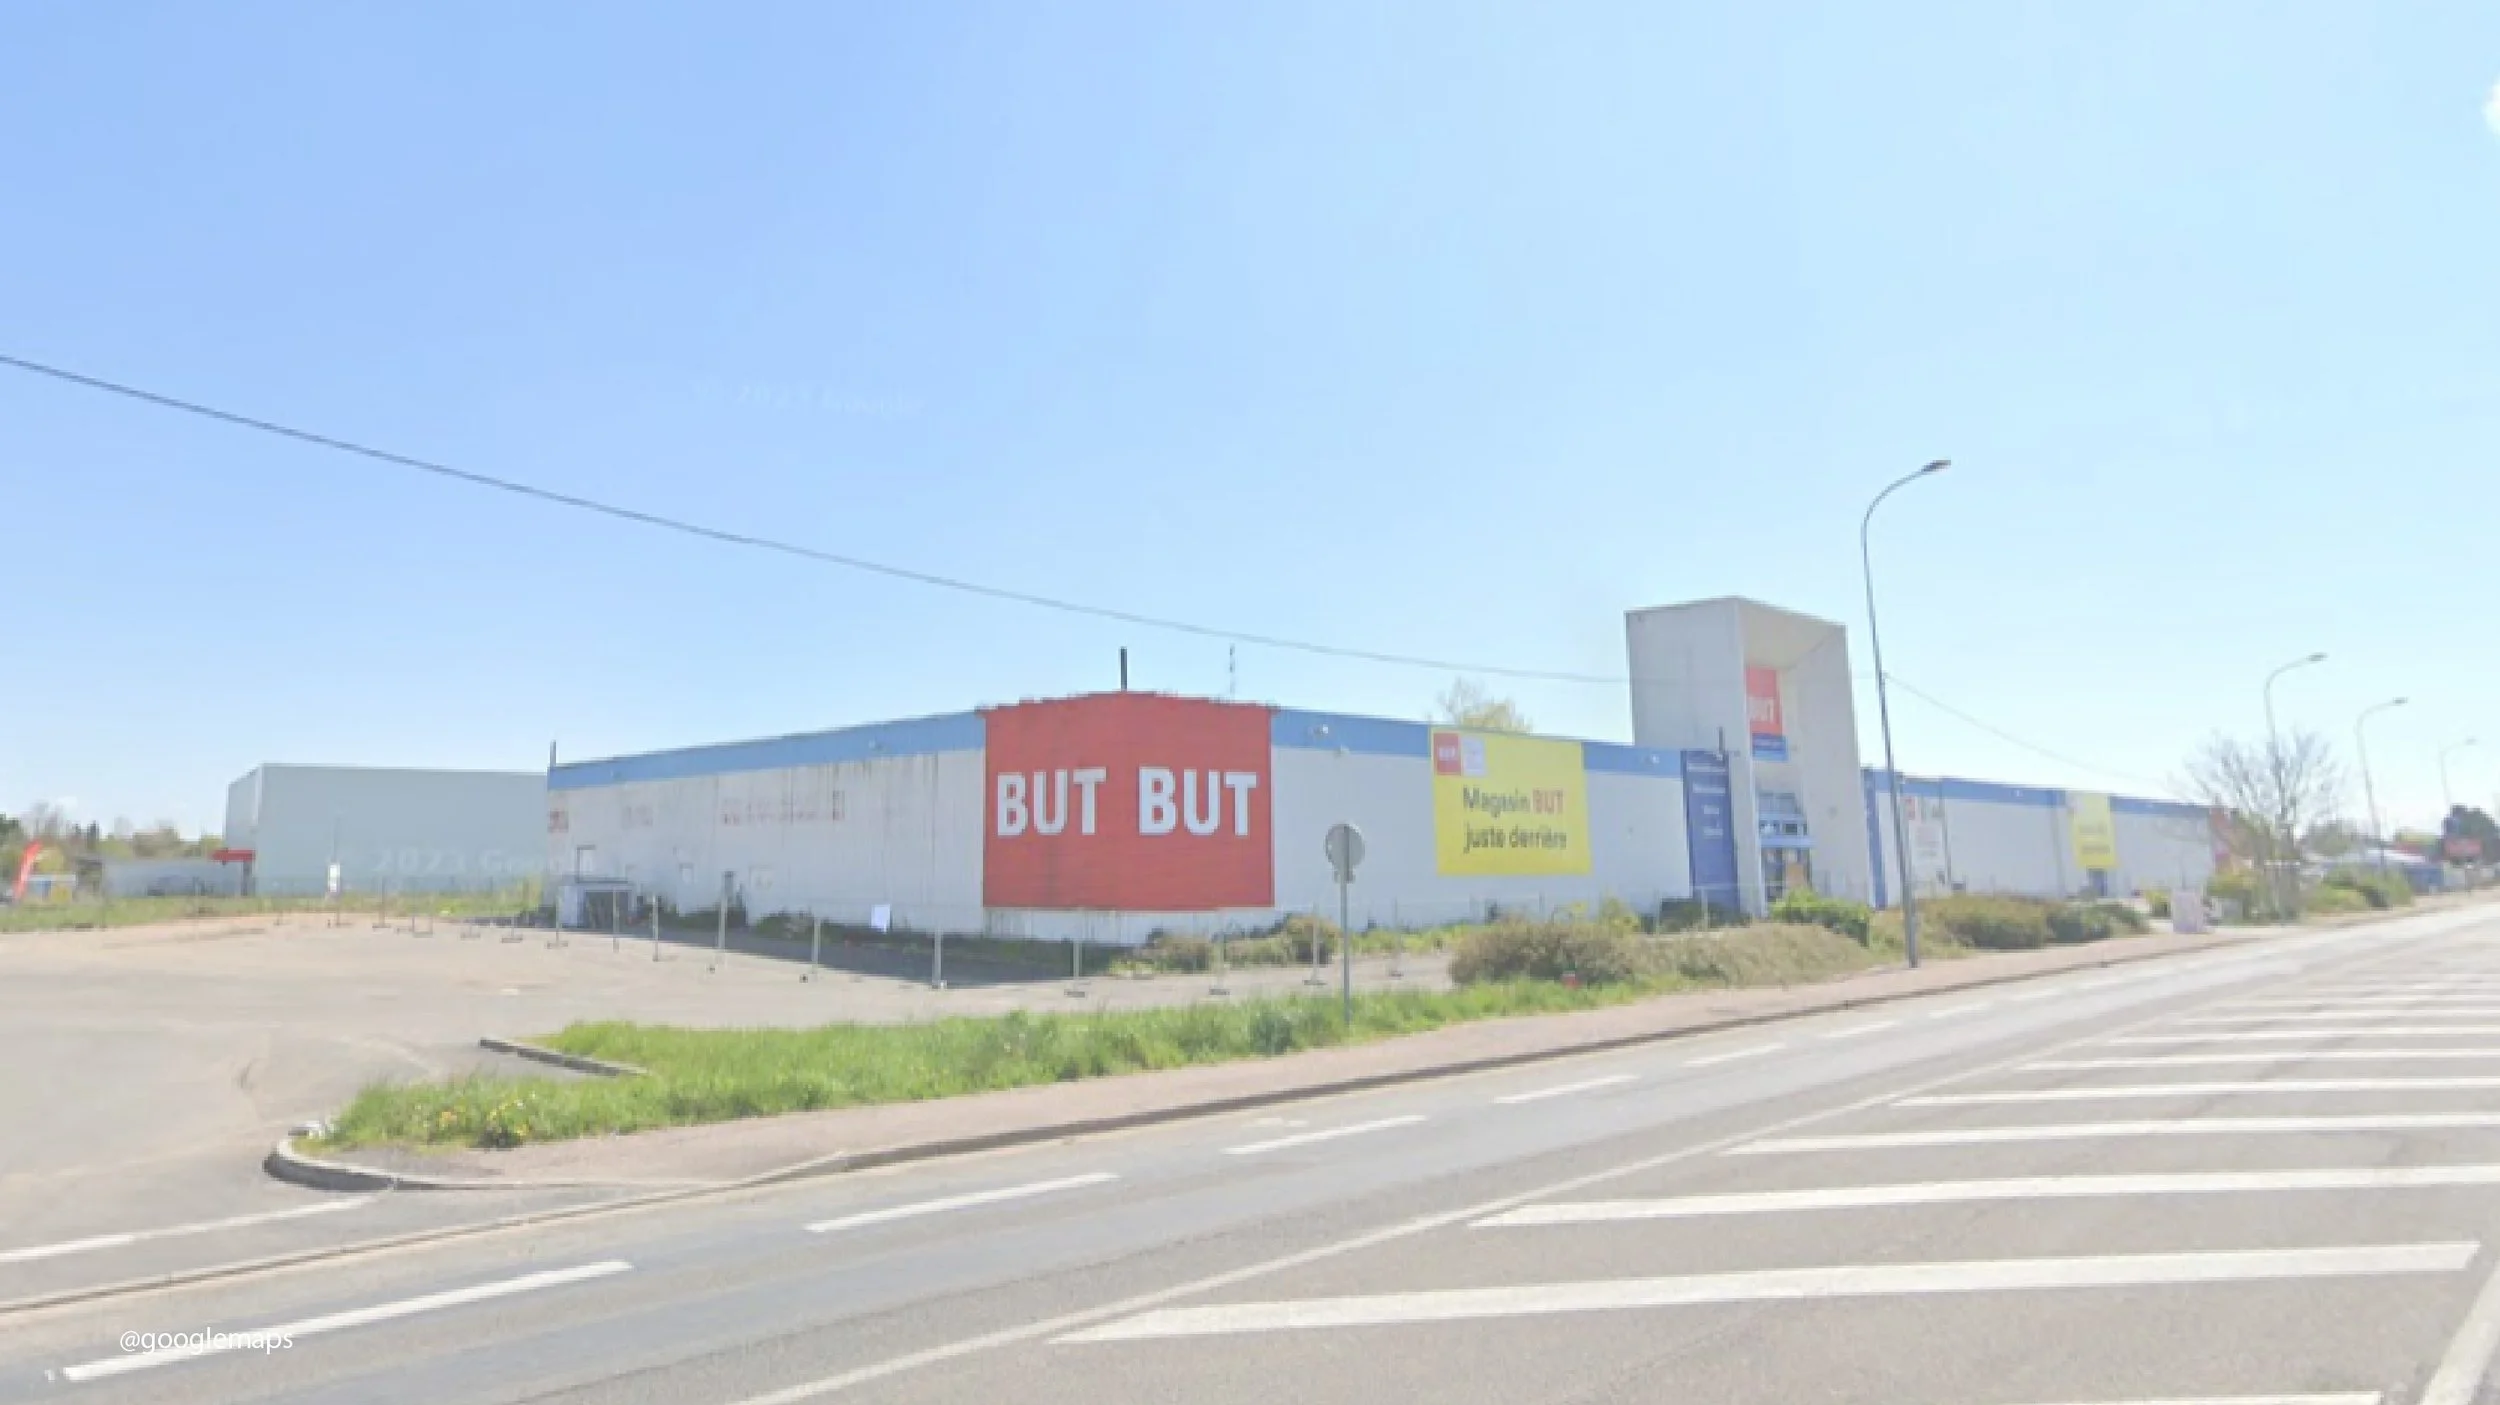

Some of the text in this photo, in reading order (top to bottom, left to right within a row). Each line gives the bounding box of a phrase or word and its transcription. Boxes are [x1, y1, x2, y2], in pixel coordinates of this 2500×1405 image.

[997, 766, 1257, 836] BUT BUT
[1463, 785, 1564, 818] Magasin BUT
[1463, 824, 1505, 854] juste
